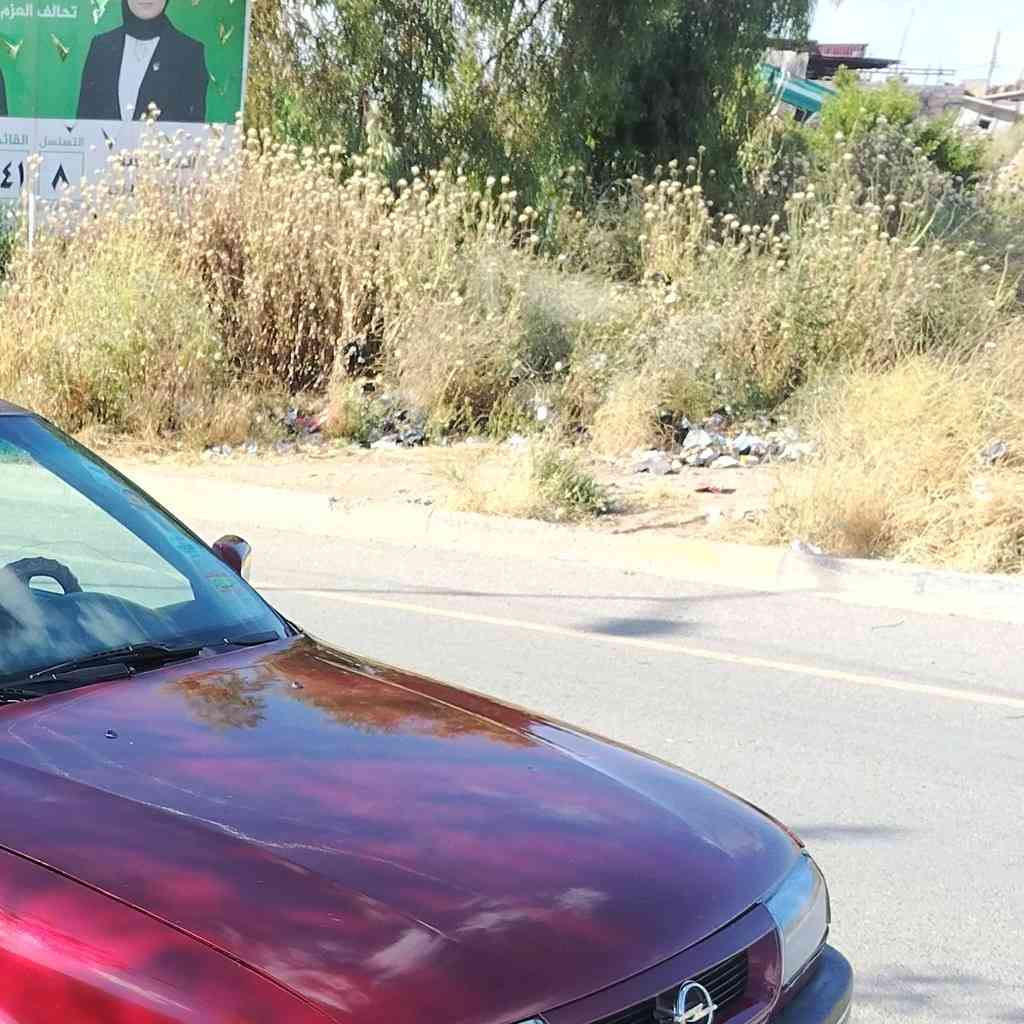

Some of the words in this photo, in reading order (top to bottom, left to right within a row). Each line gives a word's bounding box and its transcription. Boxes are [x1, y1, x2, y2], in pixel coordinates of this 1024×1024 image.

[0, 3, 33, 20] العزم
[37, 4, 78, 19] تحالف
[51, 162, 70, 190] ٨
